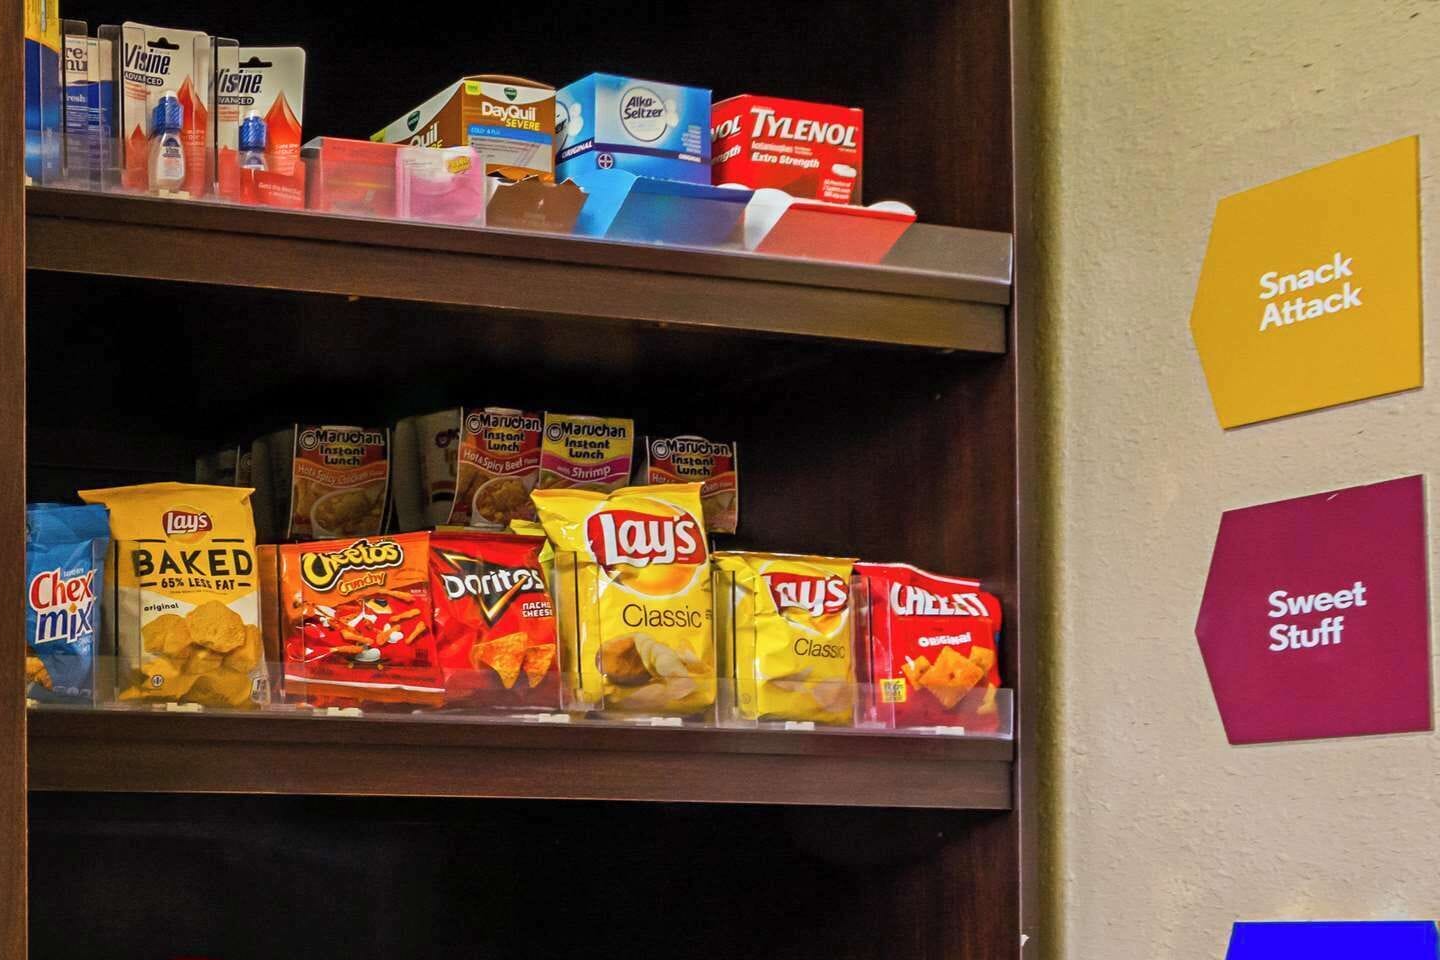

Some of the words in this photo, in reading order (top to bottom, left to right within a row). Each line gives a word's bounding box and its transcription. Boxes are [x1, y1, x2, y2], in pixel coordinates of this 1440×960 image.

[124, 43, 171, 76] Visine
[124, 72, 163, 86] ADVANCED
[481, 102, 536, 122] DayQuil
[623, 107, 664, 120] Seltzer
[505, 119, 541, 132] SEVERE
[750, 106, 857, 147] TYLENOL
[751, 152, 777, 163] Extra
[779, 154, 820, 169] Strength
[1259, 251, 1353, 300] Snack
[1259, 282, 1362, 331] Attack
[480, 413, 541, 431] Maruchan
[561, 422, 626, 438] Maruchan
[315, 430, 385, 446] Maruchan
[483, 430, 526, 442] Instant
[564, 437, 610, 449] Instant
[319, 446, 366, 456] Instant
[487, 441, 520, 452] Lunch
[569, 448, 605, 459] Lunch
[666, 439, 732, 456] Maruchan
[324, 455, 361, 466] Lunch
[484, 457, 503, 474] Spicy
[670, 455, 714, 467] Instant
[572, 465, 611, 479] Shrimp
[676, 465, 711, 476] Lunch
[166, 511, 209, 535] Lay's
[599, 511, 697, 567] Lay's
[132, 548, 253, 578] BAKED
[300, 539, 403, 591] Cheetos
[30, 568, 96, 610] Chex
[161, 577, 185, 589] 65%
[188, 579, 212, 590] LESS
[216, 579, 236, 591] FAT
[337, 571, 387, 596] Crunchy
[442, 567, 546, 600] Doritos
[762, 575, 848, 617] ay's
[1268, 581, 1368, 618] Sweet
[143, 602, 180, 612] original
[622, 603, 703, 628] Classic
[35, 601, 94, 644] mix
[1268, 615, 1345, 652] Stuff
